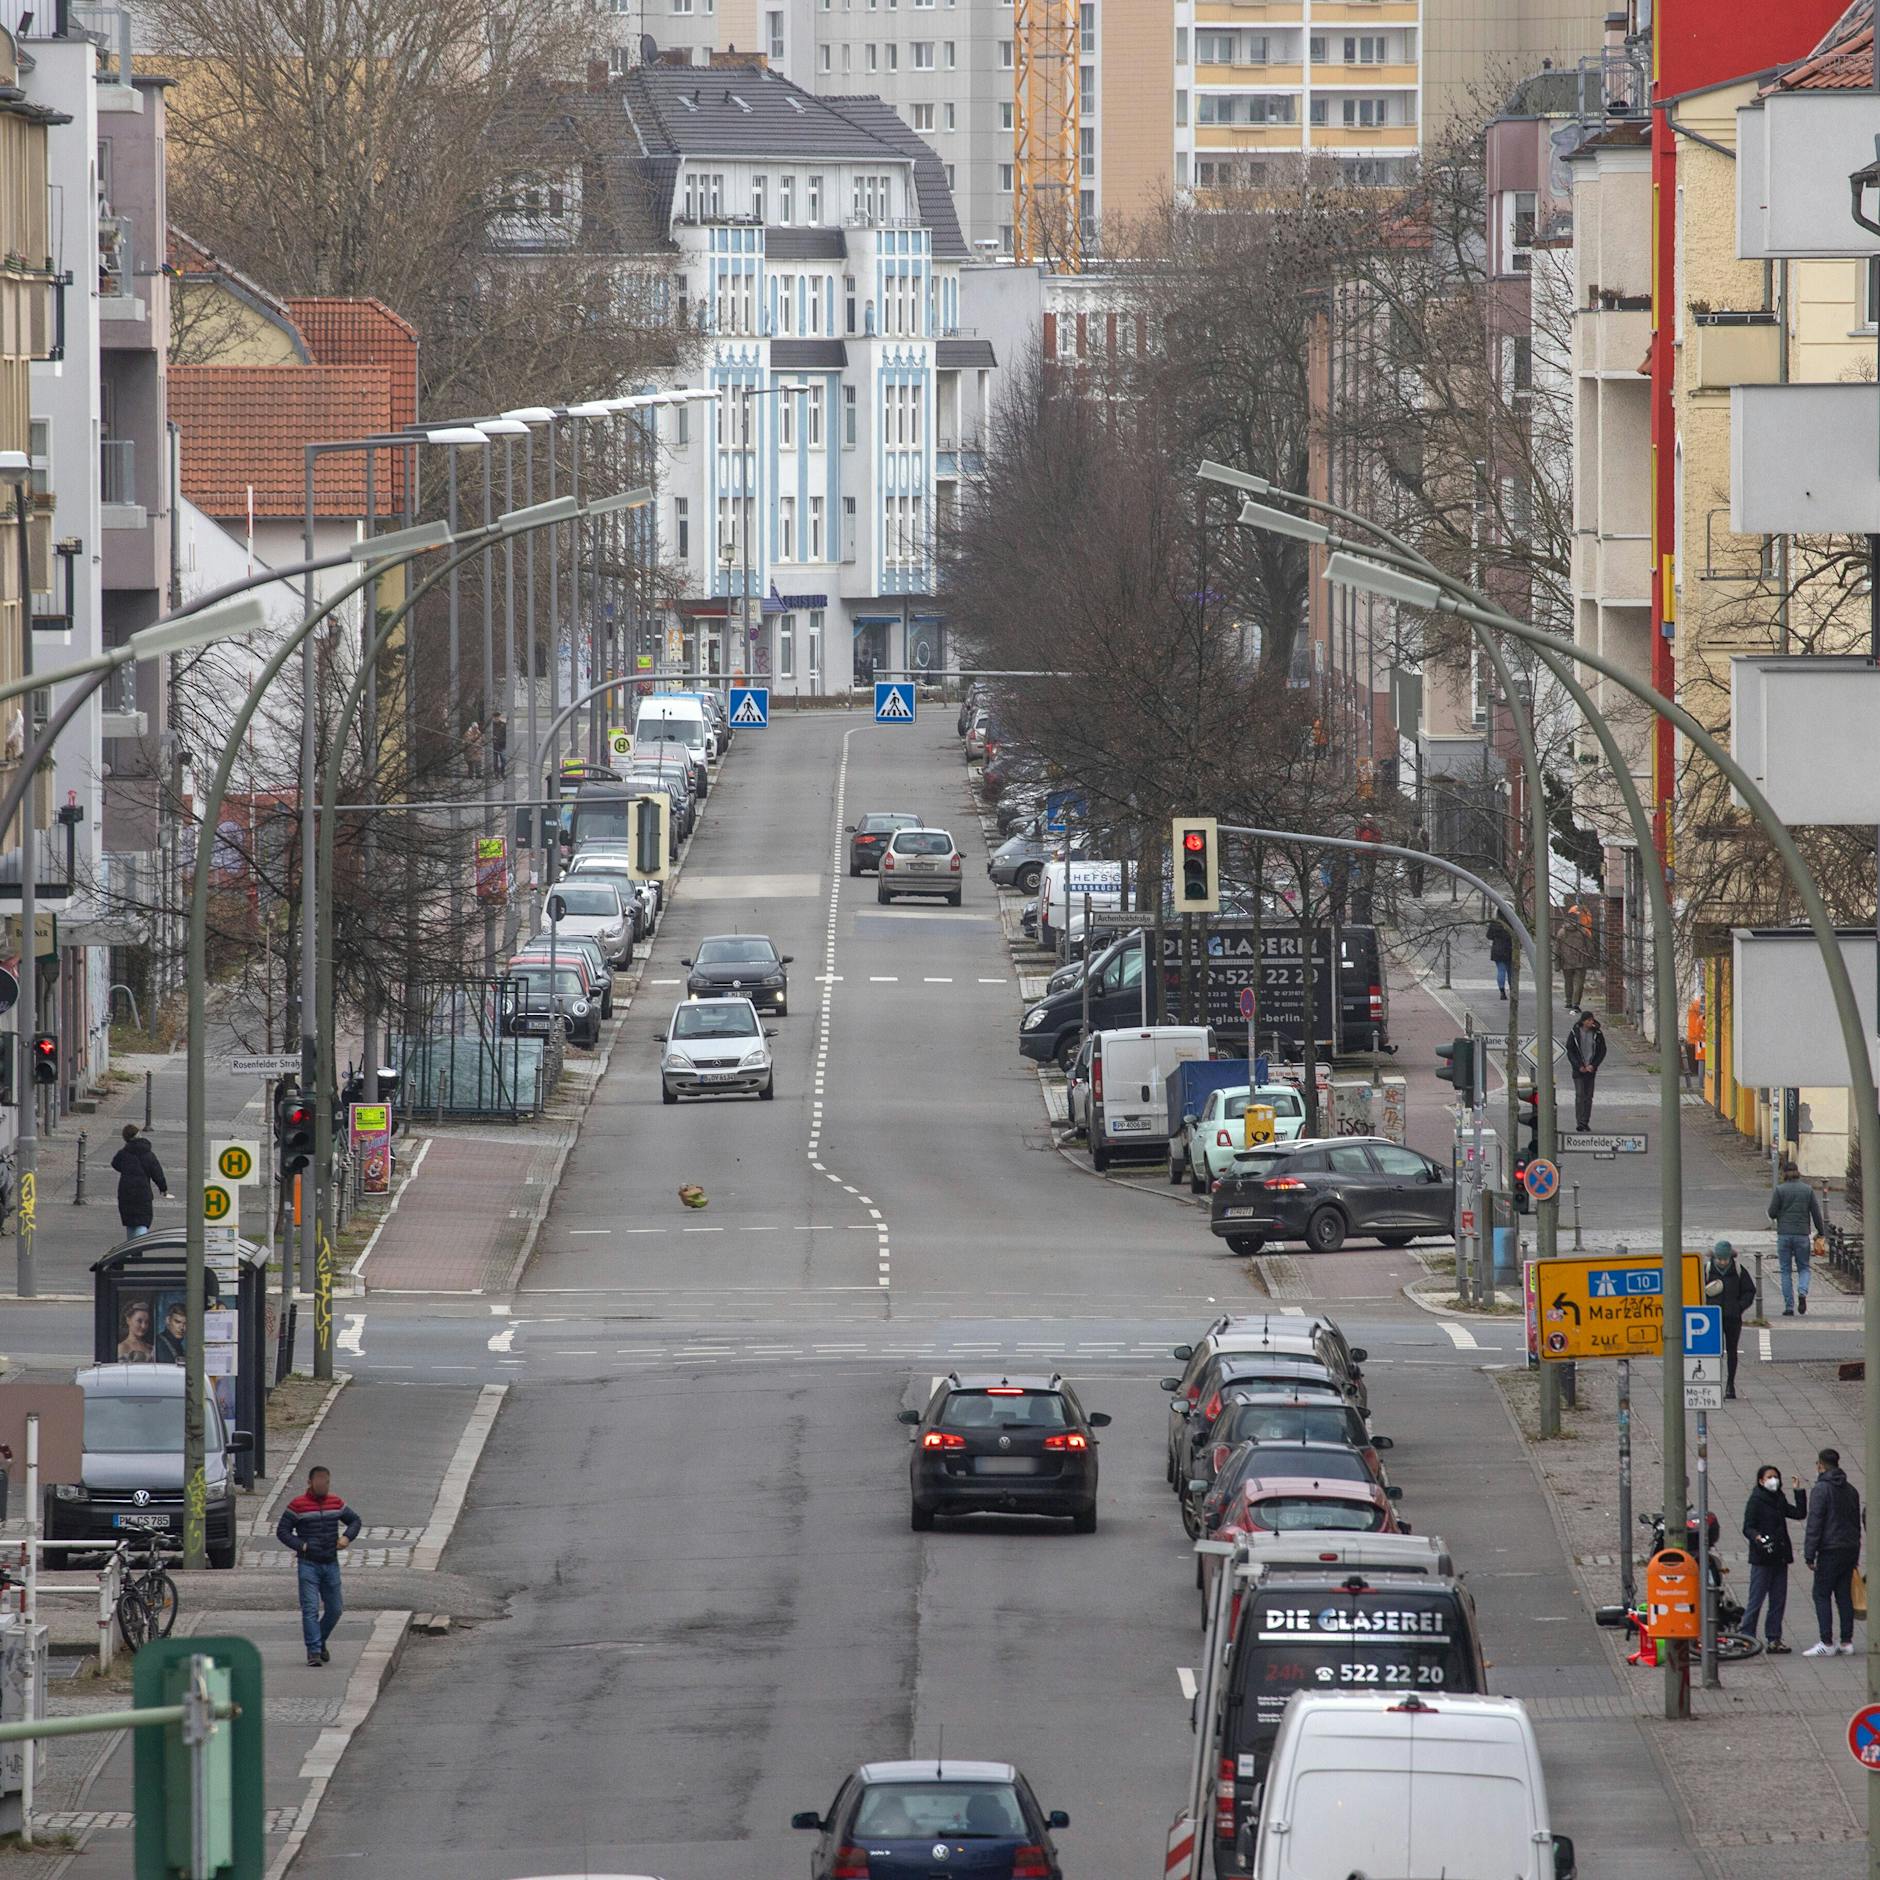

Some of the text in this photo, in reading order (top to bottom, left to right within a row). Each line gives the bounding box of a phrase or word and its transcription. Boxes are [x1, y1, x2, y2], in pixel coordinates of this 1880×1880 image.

[1266, 969, 1289, 984] 22
[233, 1060, 277, 1068] Rosenfelder
[1566, 1137, 1614, 1147] Rosenfelder
[1636, 1276, 1650, 1289] 10
[1590, 1302, 1664, 1320] Marzahn
[1685, 1312, 1711, 1349] P
[1591, 1334, 1618, 1346] zur
[1686, 1388, 1711, 1397] Mo-Fr
[1688, 1398, 1717, 1407] 07-19h
[151, 1516, 169, 1526] 785
[1318, 1608, 1443, 1632] GLASEREI
[1265, 1664, 1444, 1683] 24h 522 22 20
